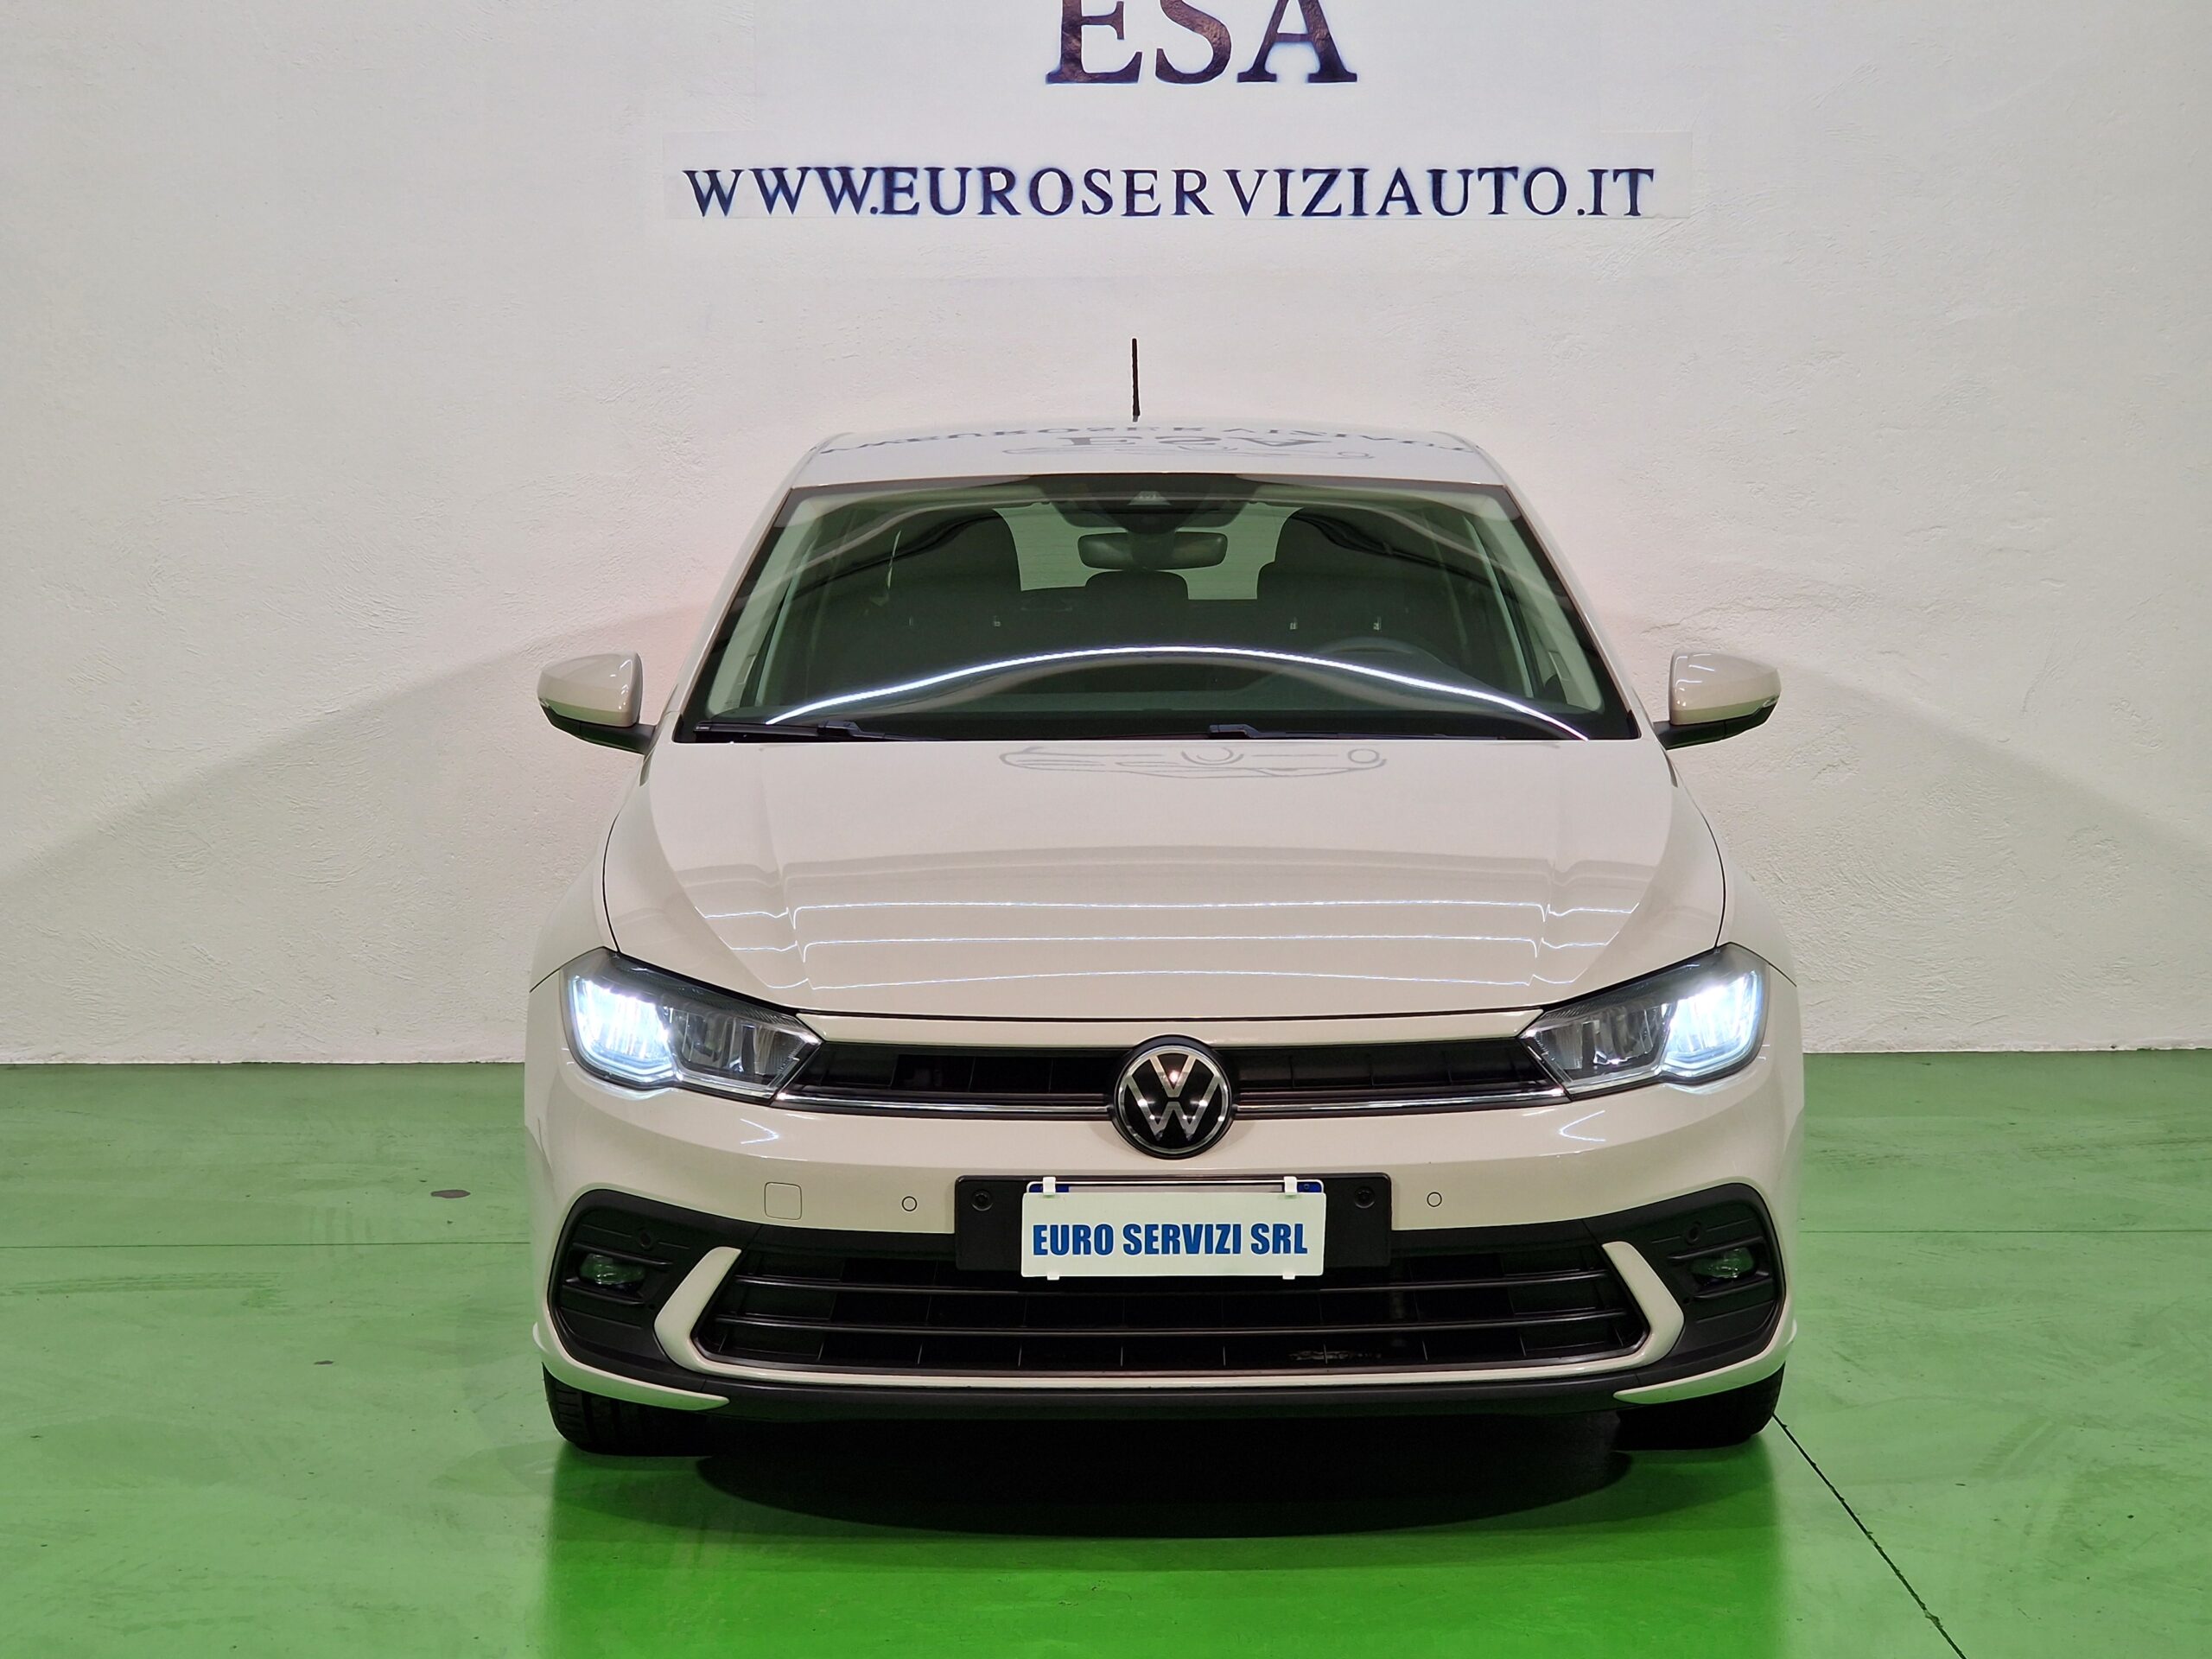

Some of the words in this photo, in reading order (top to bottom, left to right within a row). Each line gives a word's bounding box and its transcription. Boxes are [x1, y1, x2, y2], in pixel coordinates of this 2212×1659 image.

[1046, 0, 1357, 84] ESA
[683, 166, 1655, 217] WWW.EUROSERVIZIAUTO.IT
[1033, 1223, 1114, 1256] EURO
[1122, 1223, 1242, 1255] SERVIZI
[1250, 1223, 1308, 1255] SRL
